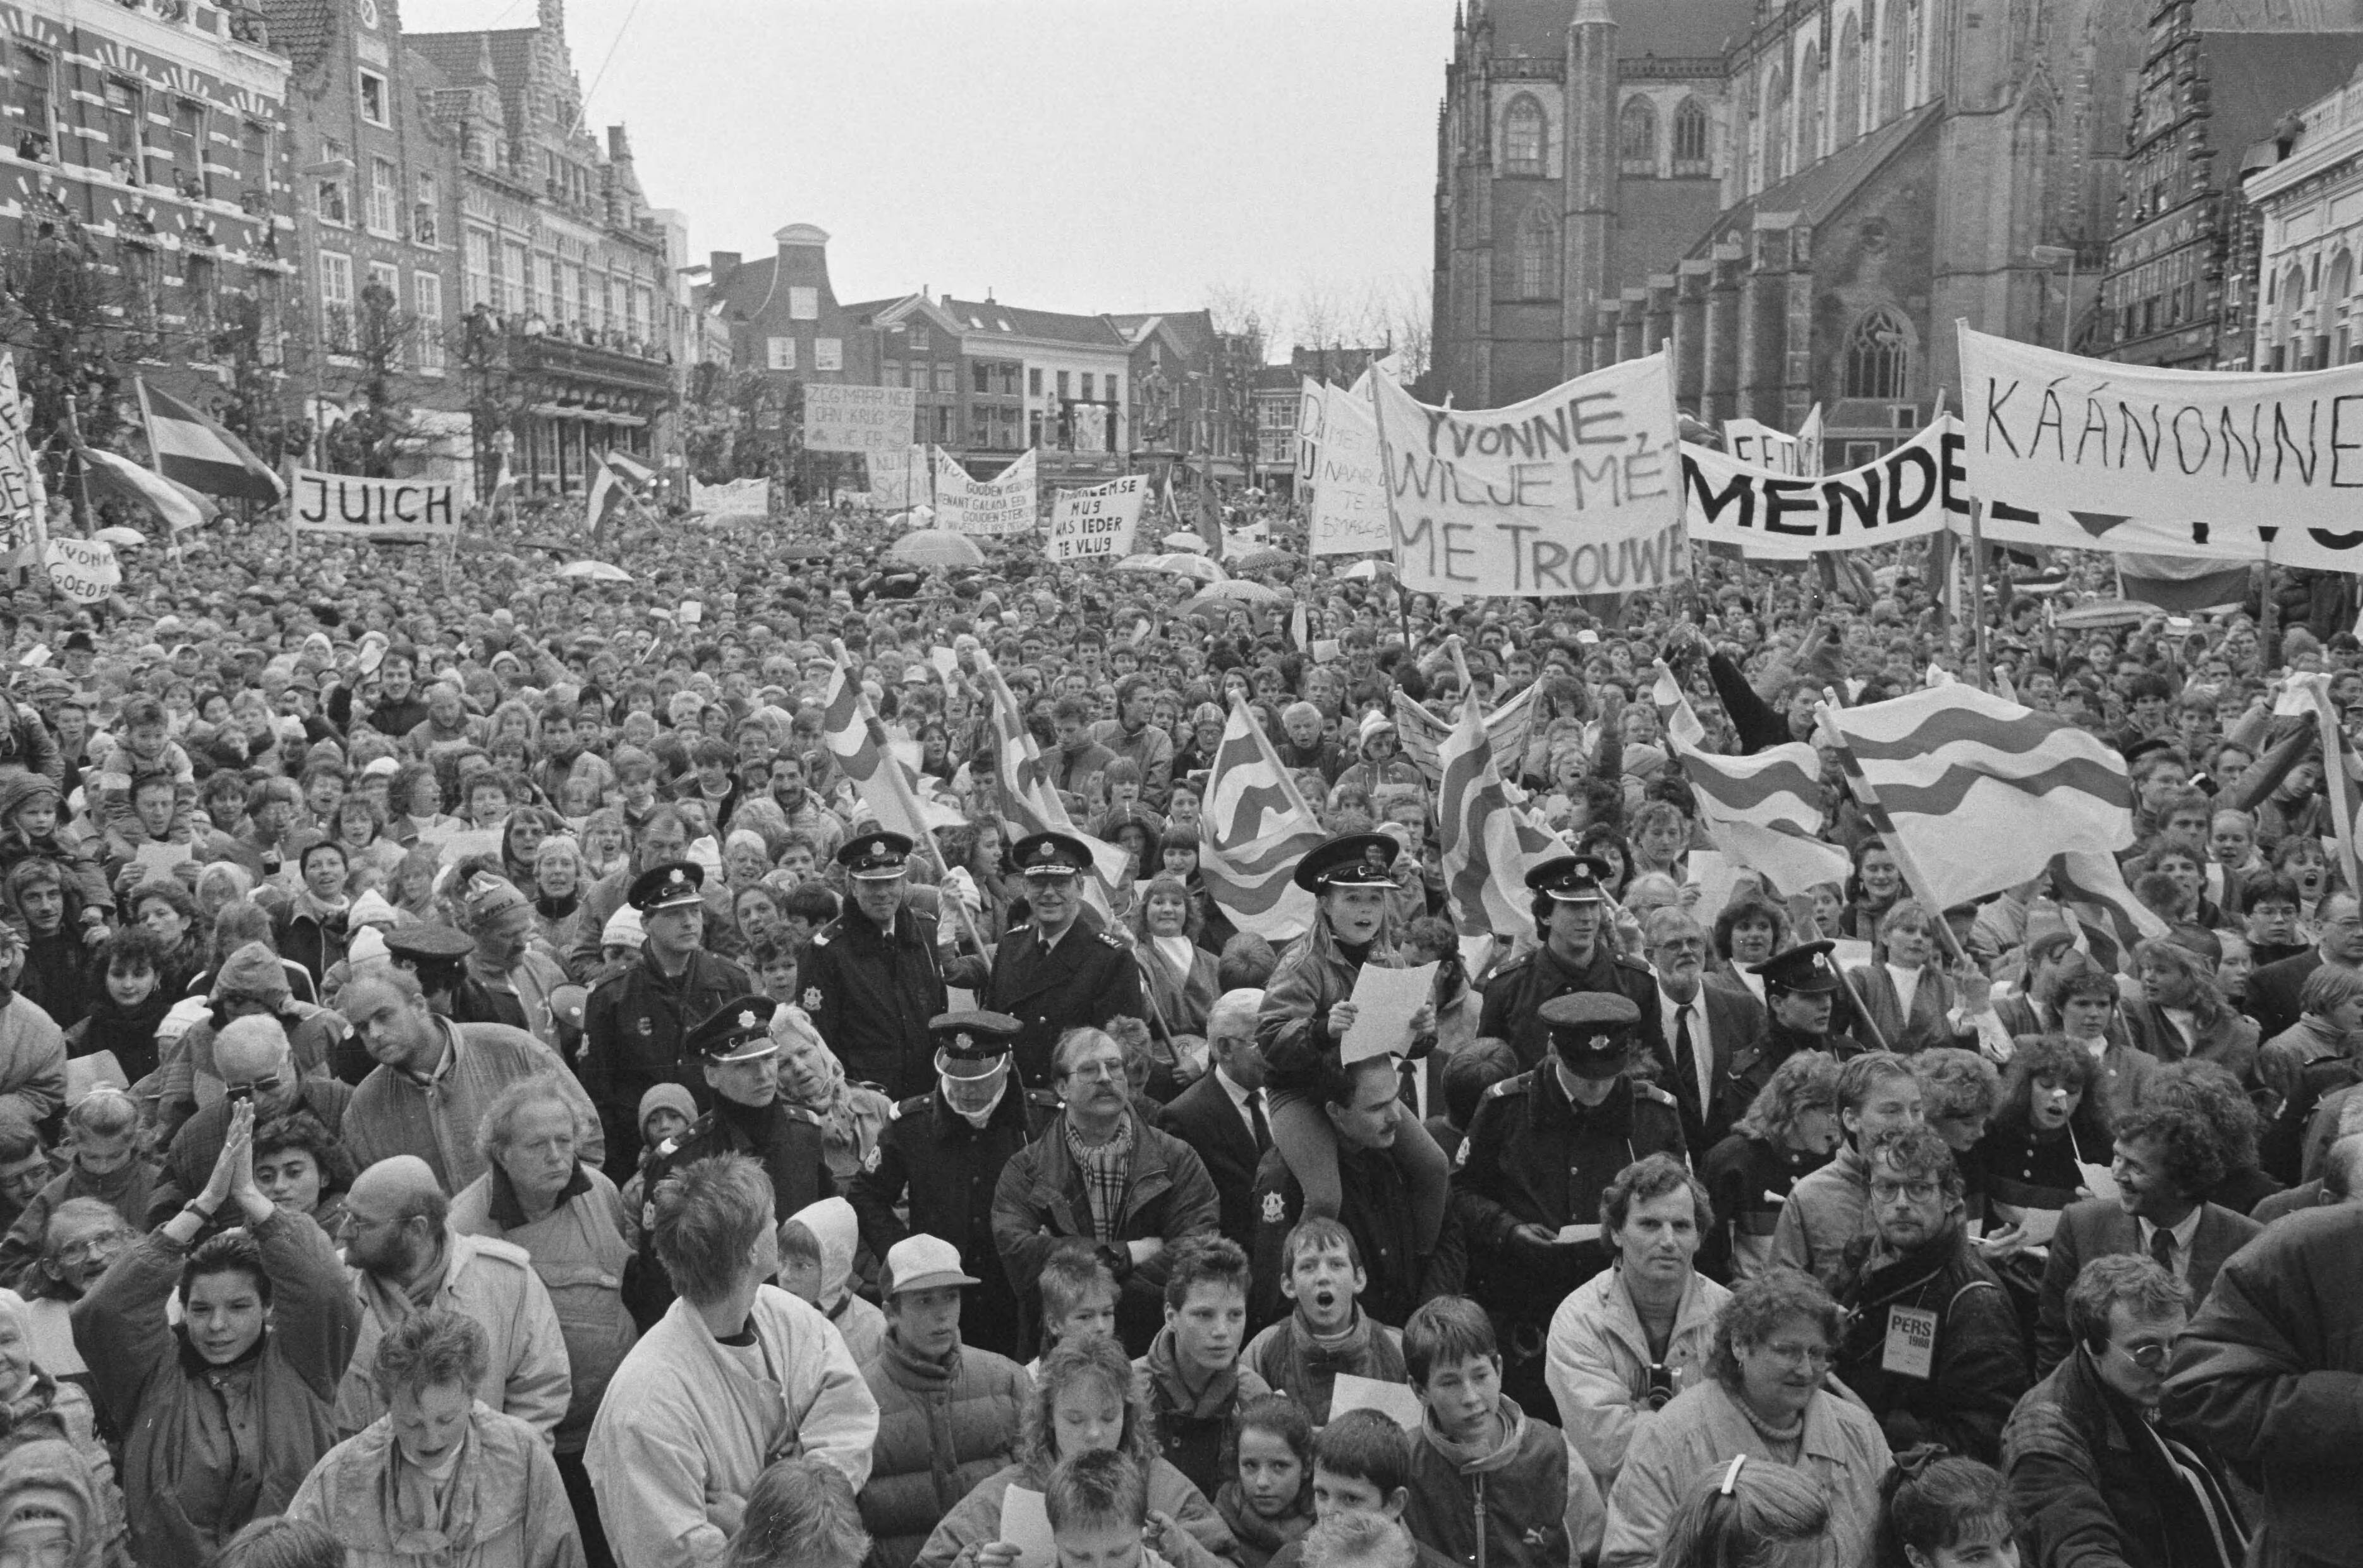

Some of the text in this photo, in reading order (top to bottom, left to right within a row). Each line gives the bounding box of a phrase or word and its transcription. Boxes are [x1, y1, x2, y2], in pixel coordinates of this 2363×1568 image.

[808, 386, 913, 407] ZEG MAAR NEE
[815, 406, 842, 423] DAN
[1423, 390, 1649, 459] YVONNE,
[865, 430, 883, 447] ER
[1325, 459, 1372, 485] NAAR
[299, 475, 453, 525] JUICH
[1082, 516, 1123, 534] IEDER
[1058, 540, 1070, 557] TE
[1394, 509, 1479, 583] ME
[1891, 1315, 1932, 1337] PERS
